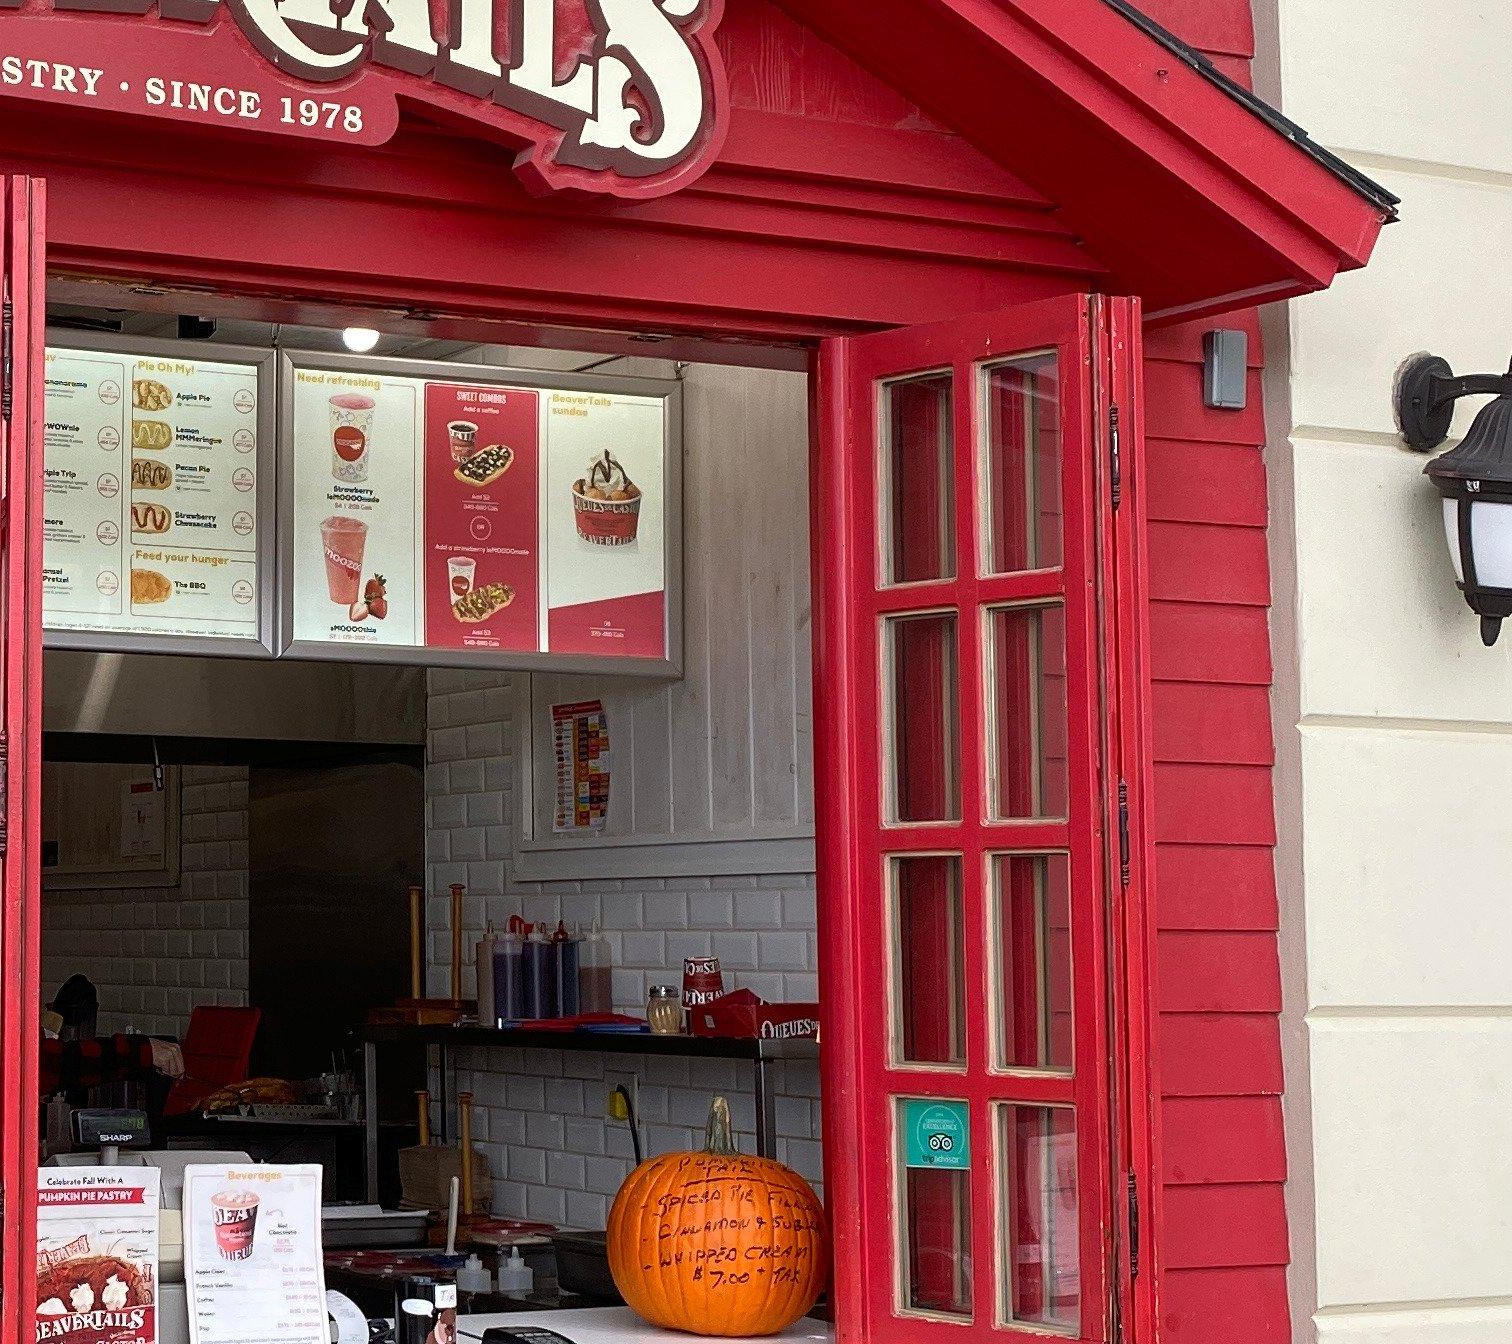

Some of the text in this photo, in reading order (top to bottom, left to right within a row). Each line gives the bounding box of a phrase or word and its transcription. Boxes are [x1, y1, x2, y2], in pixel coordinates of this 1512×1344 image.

[144, 76, 263, 122] SINCE
[279, 94, 364, 135] 1978
[297, 373, 381, 391] Need refreshing
[176, 392, 211, 403] Apple Pie
[456, 390, 478, 402] SWEET
[552, 393, 612, 407] BeaverTails
[176, 426, 200, 435] Lemon
[175, 463, 211, 474] Pecan Pie
[333, 484, 374, 495] Strawberry
[175, 511, 217, 522] Strawberry
[175, 519, 218, 530] Cheesecake
[135, 549, 230, 568] Feed your hunger
[175, 580, 207, 591] The BBQ
[99, 1134, 133, 1142] SHARP
[46, 1177, 82, 1186] Celebrate
[82, 1177, 96, 1185] Fall
[97, 1177, 116, 1185] With
[226, 1170, 283, 1183] Beverages
[38, 1190, 134, 1203] PUMPKIN PIE PASTRY
